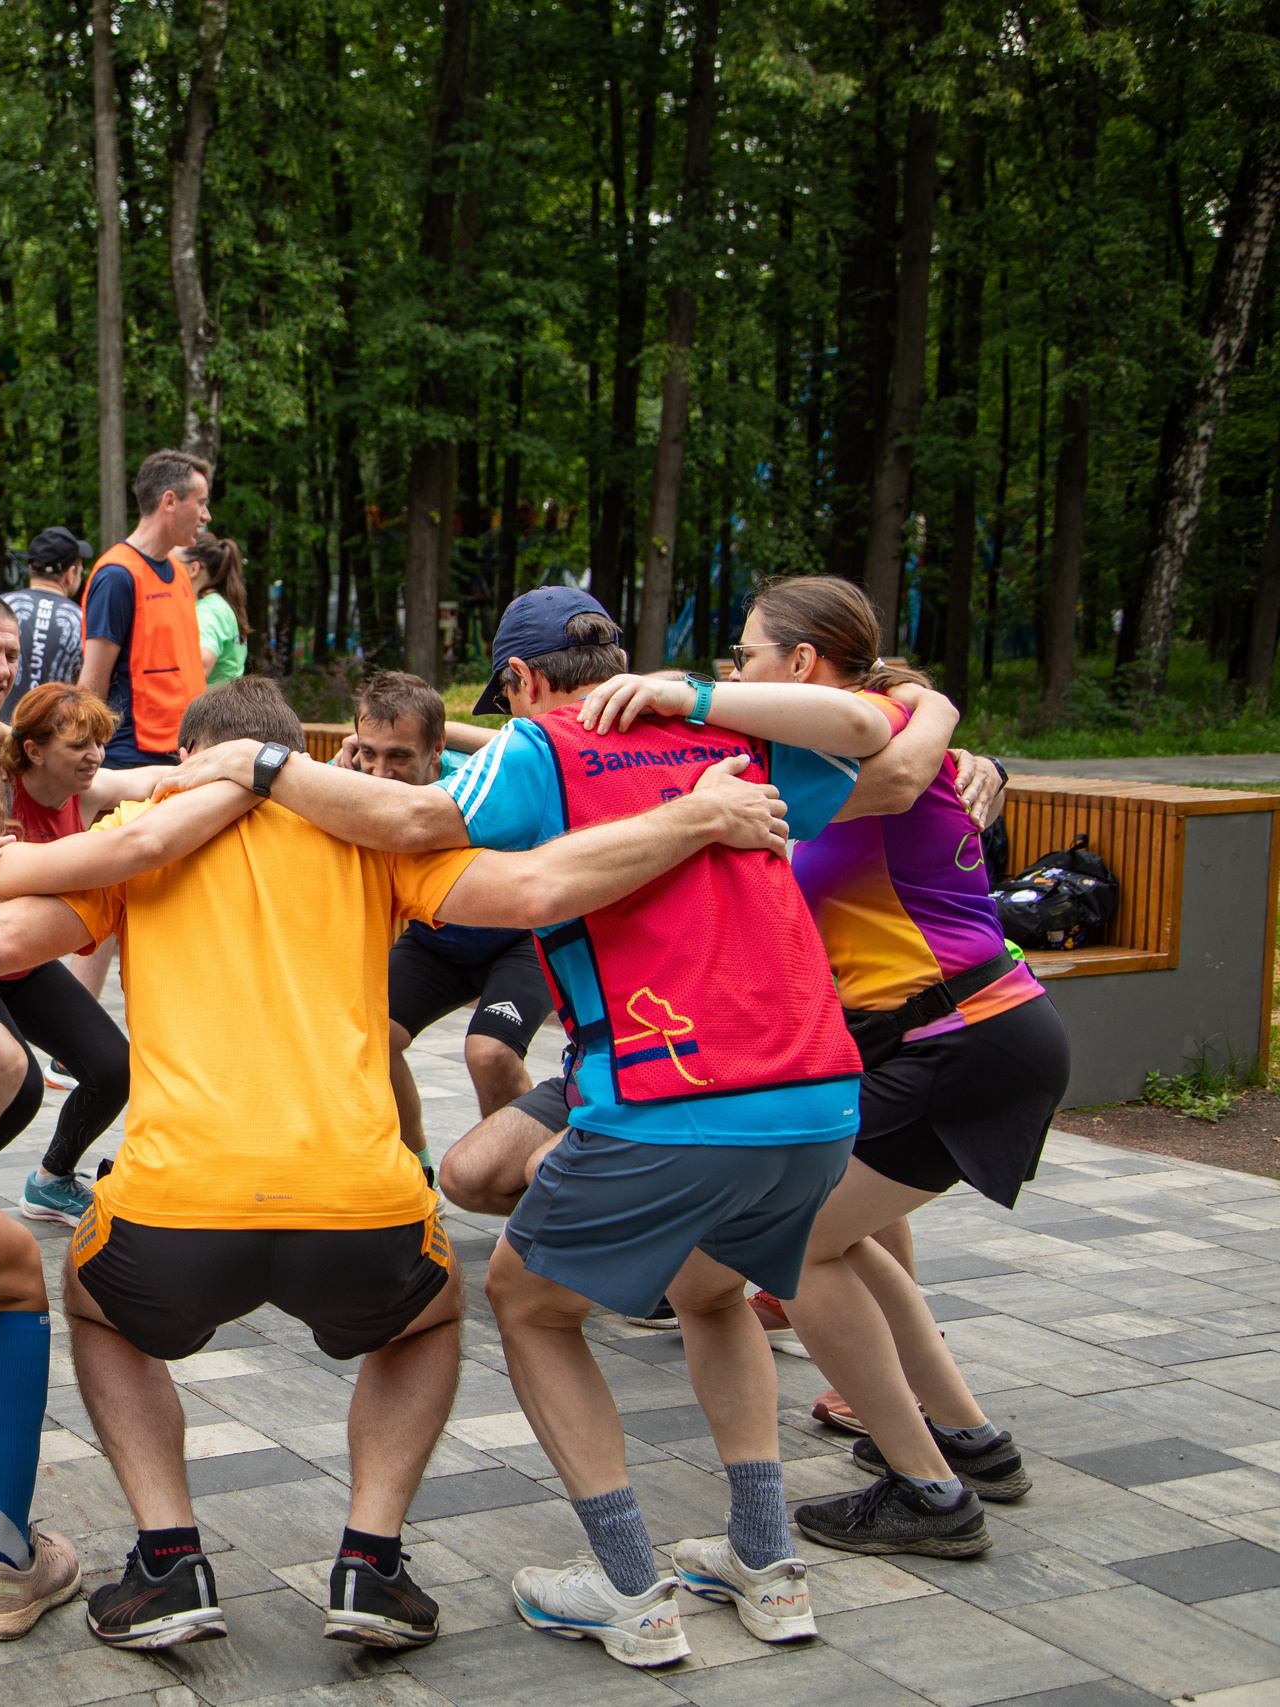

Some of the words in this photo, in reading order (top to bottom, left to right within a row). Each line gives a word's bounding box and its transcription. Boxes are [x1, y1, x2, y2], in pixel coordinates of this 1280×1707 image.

[30, 598, 54, 690] OLUNTEER
[502, 1013, 522, 1026] TRAIL
[760, 1593, 810, 1606] ANT
